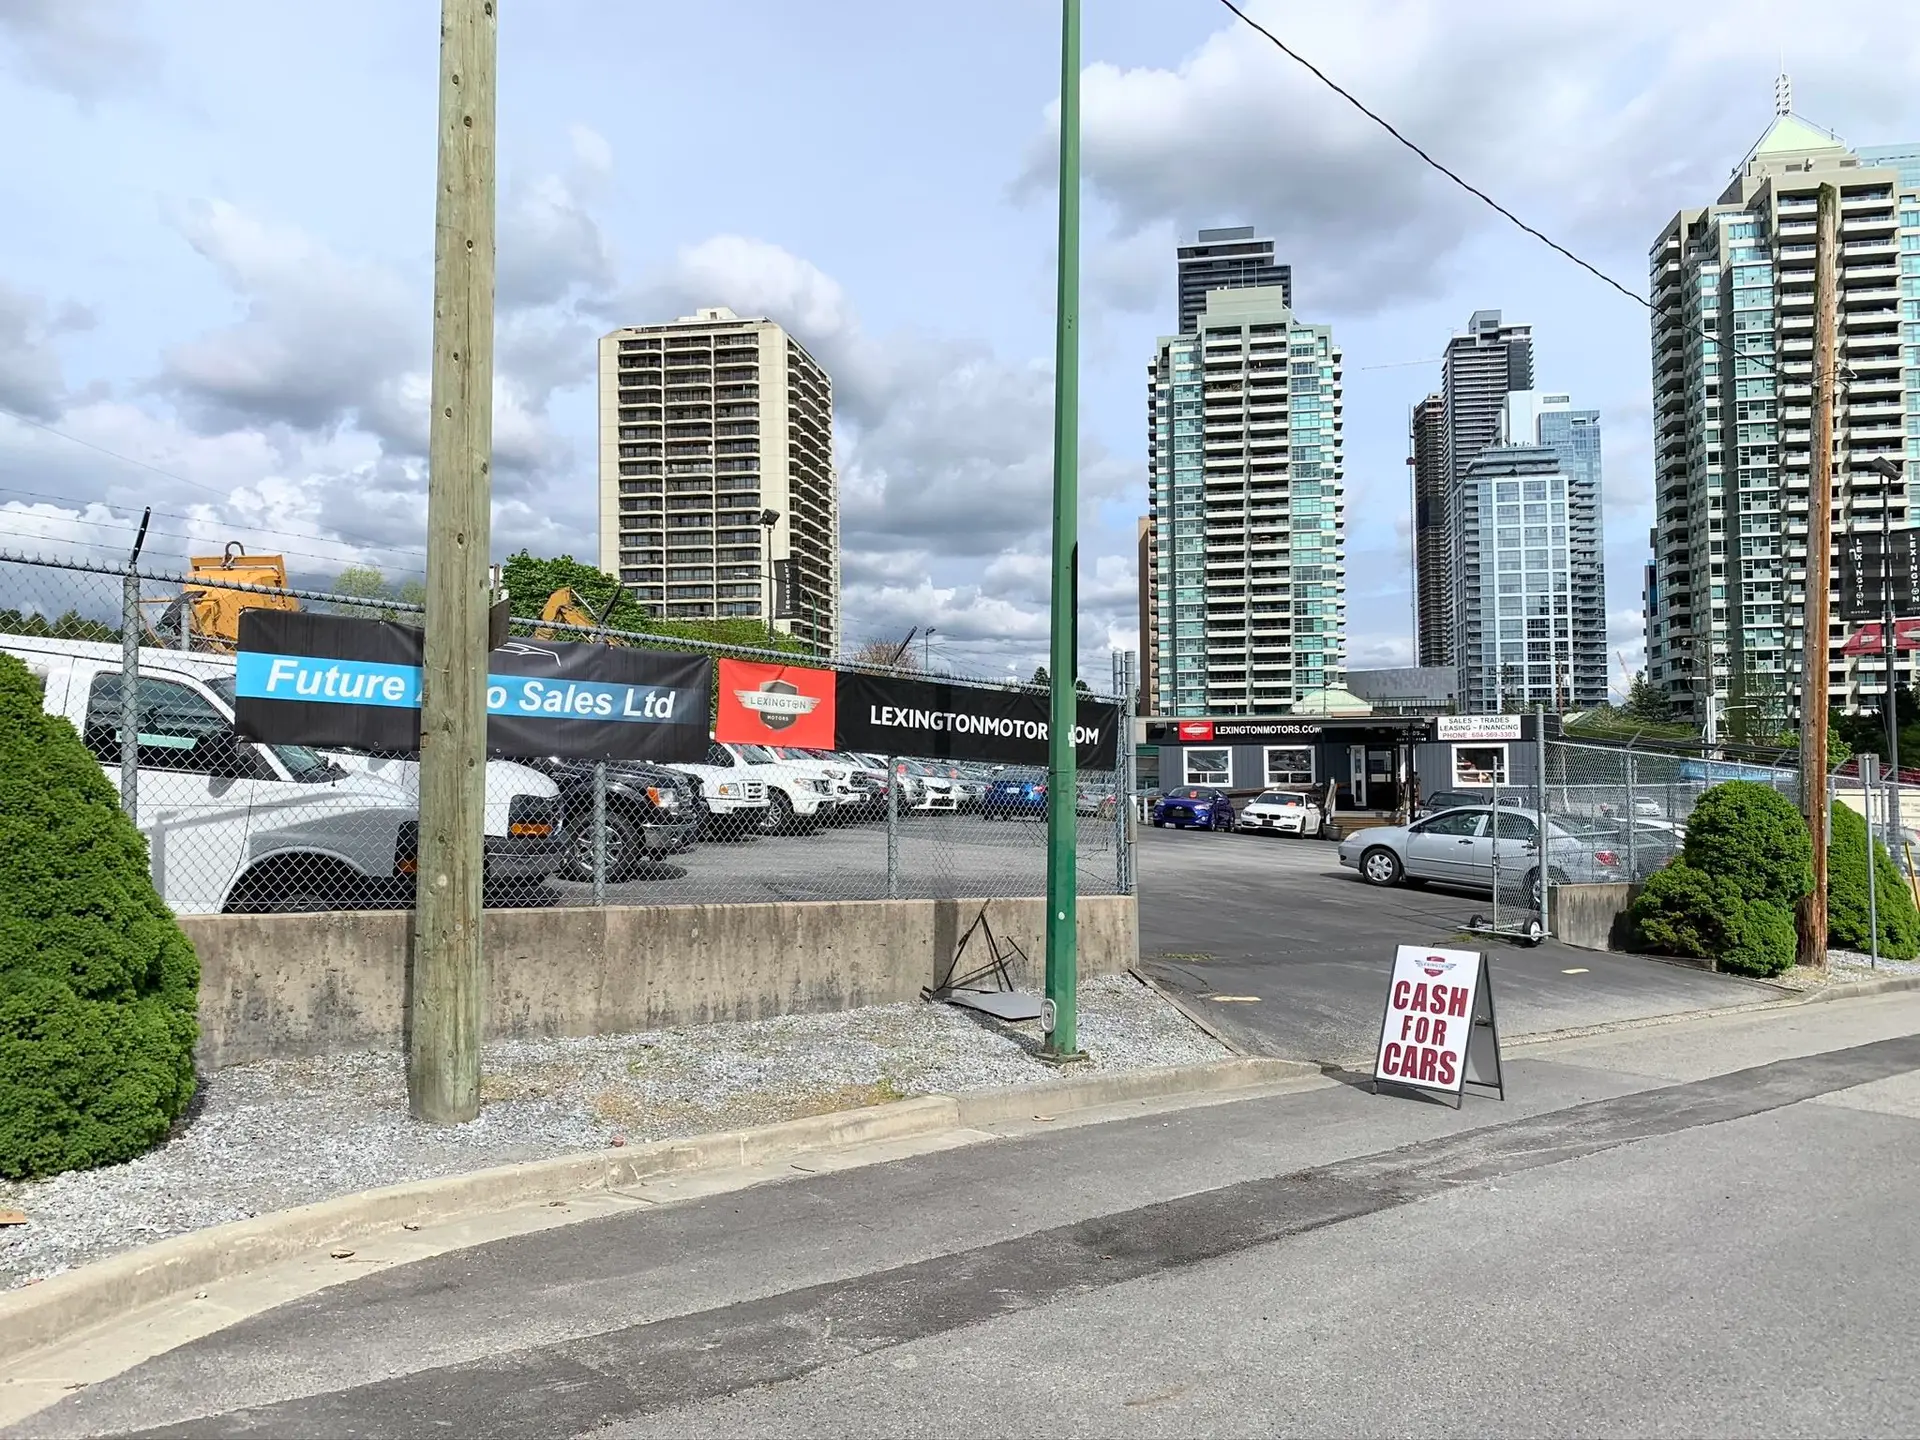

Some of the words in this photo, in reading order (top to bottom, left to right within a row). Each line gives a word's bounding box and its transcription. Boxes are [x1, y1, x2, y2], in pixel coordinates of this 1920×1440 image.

[266, 659, 406, 701] Future
[518, 680, 613, 716] Sales
[623, 687, 677, 720] Ltd
[750, 696, 806, 709] LEXINGTON
[870, 704, 1099, 745] LEXINGTONMOTOROM
[1393, 980, 1469, 1018] CASH
[1400, 1015, 1447, 1047] FOR
[1382, 1042, 1457, 1085] CARS
